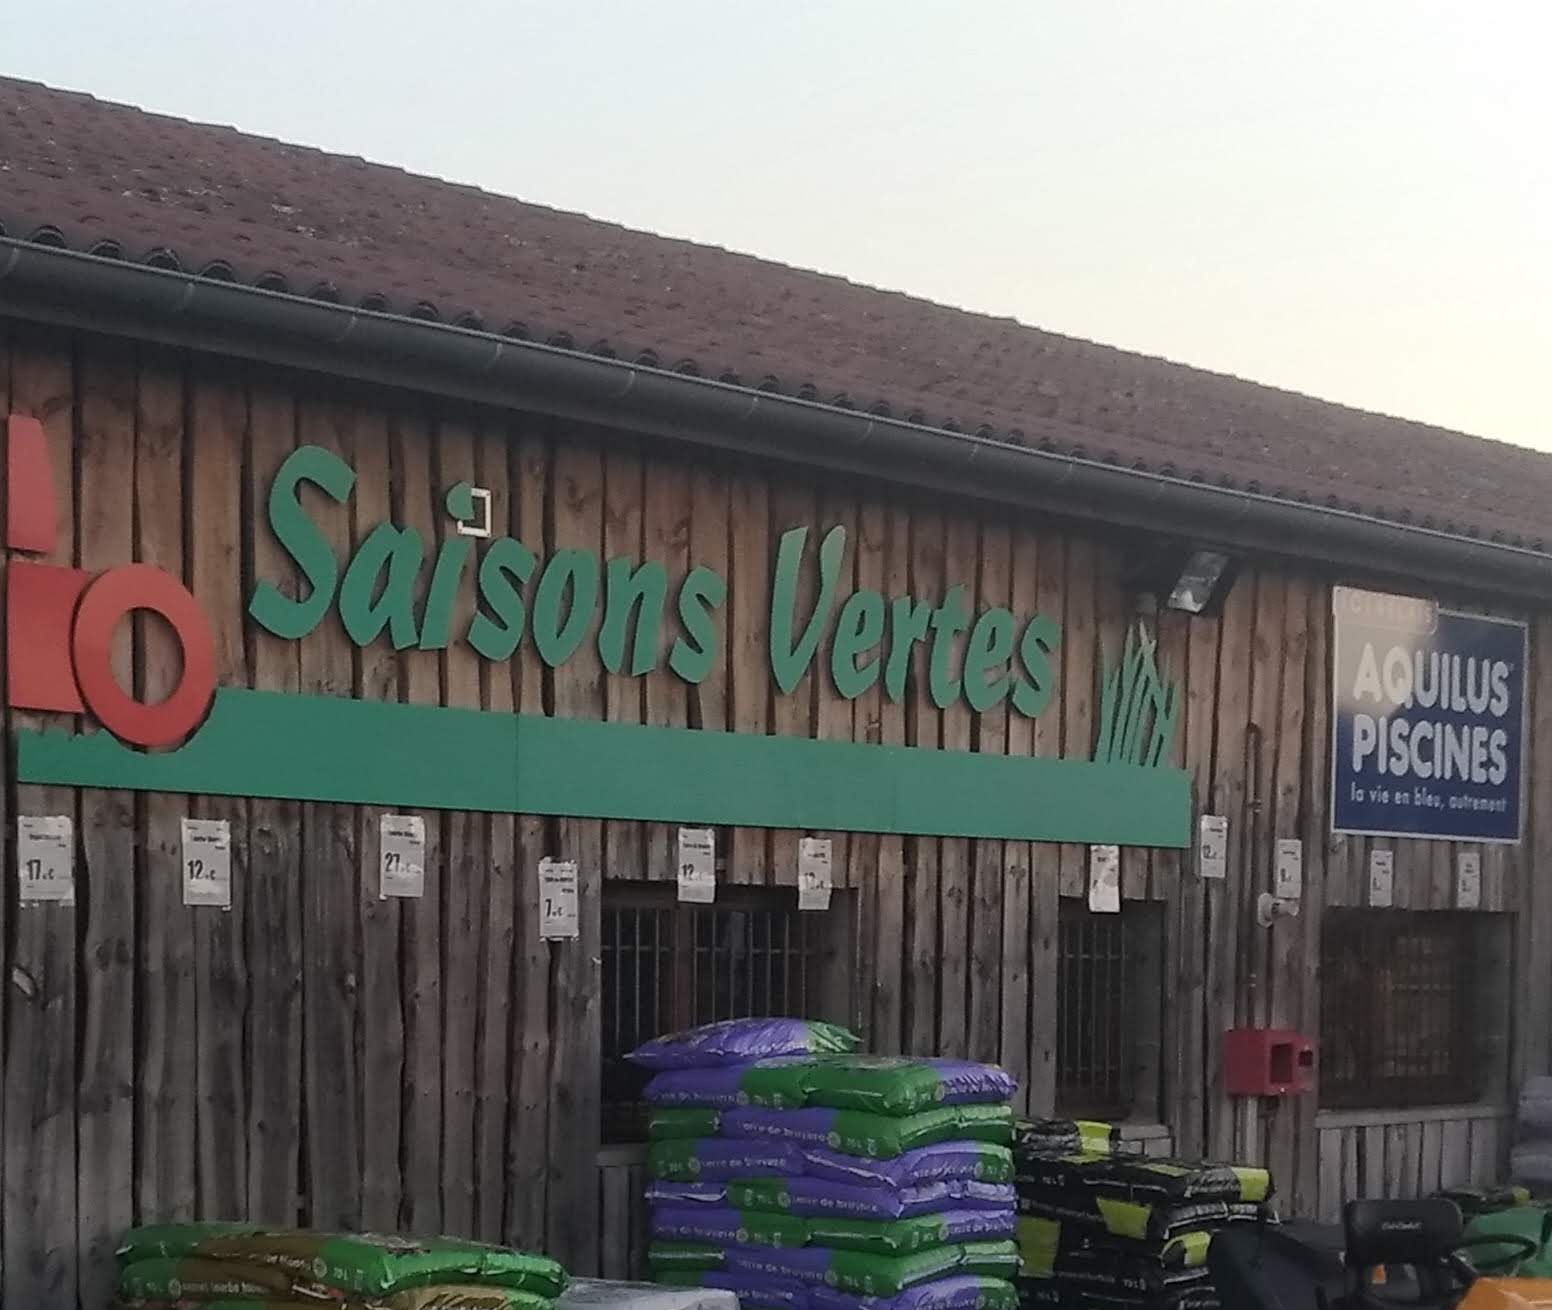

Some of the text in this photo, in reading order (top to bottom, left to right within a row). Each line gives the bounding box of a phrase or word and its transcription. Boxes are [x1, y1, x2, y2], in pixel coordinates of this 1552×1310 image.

[249, 445, 1060, 718] Saisons Vertes
[1353, 642, 1509, 717] AQUILUS
[1353, 713, 1507, 785] PISCINES
[1351, 781, 1364, 801] la
[1370, 785, 1389, 804] vie
